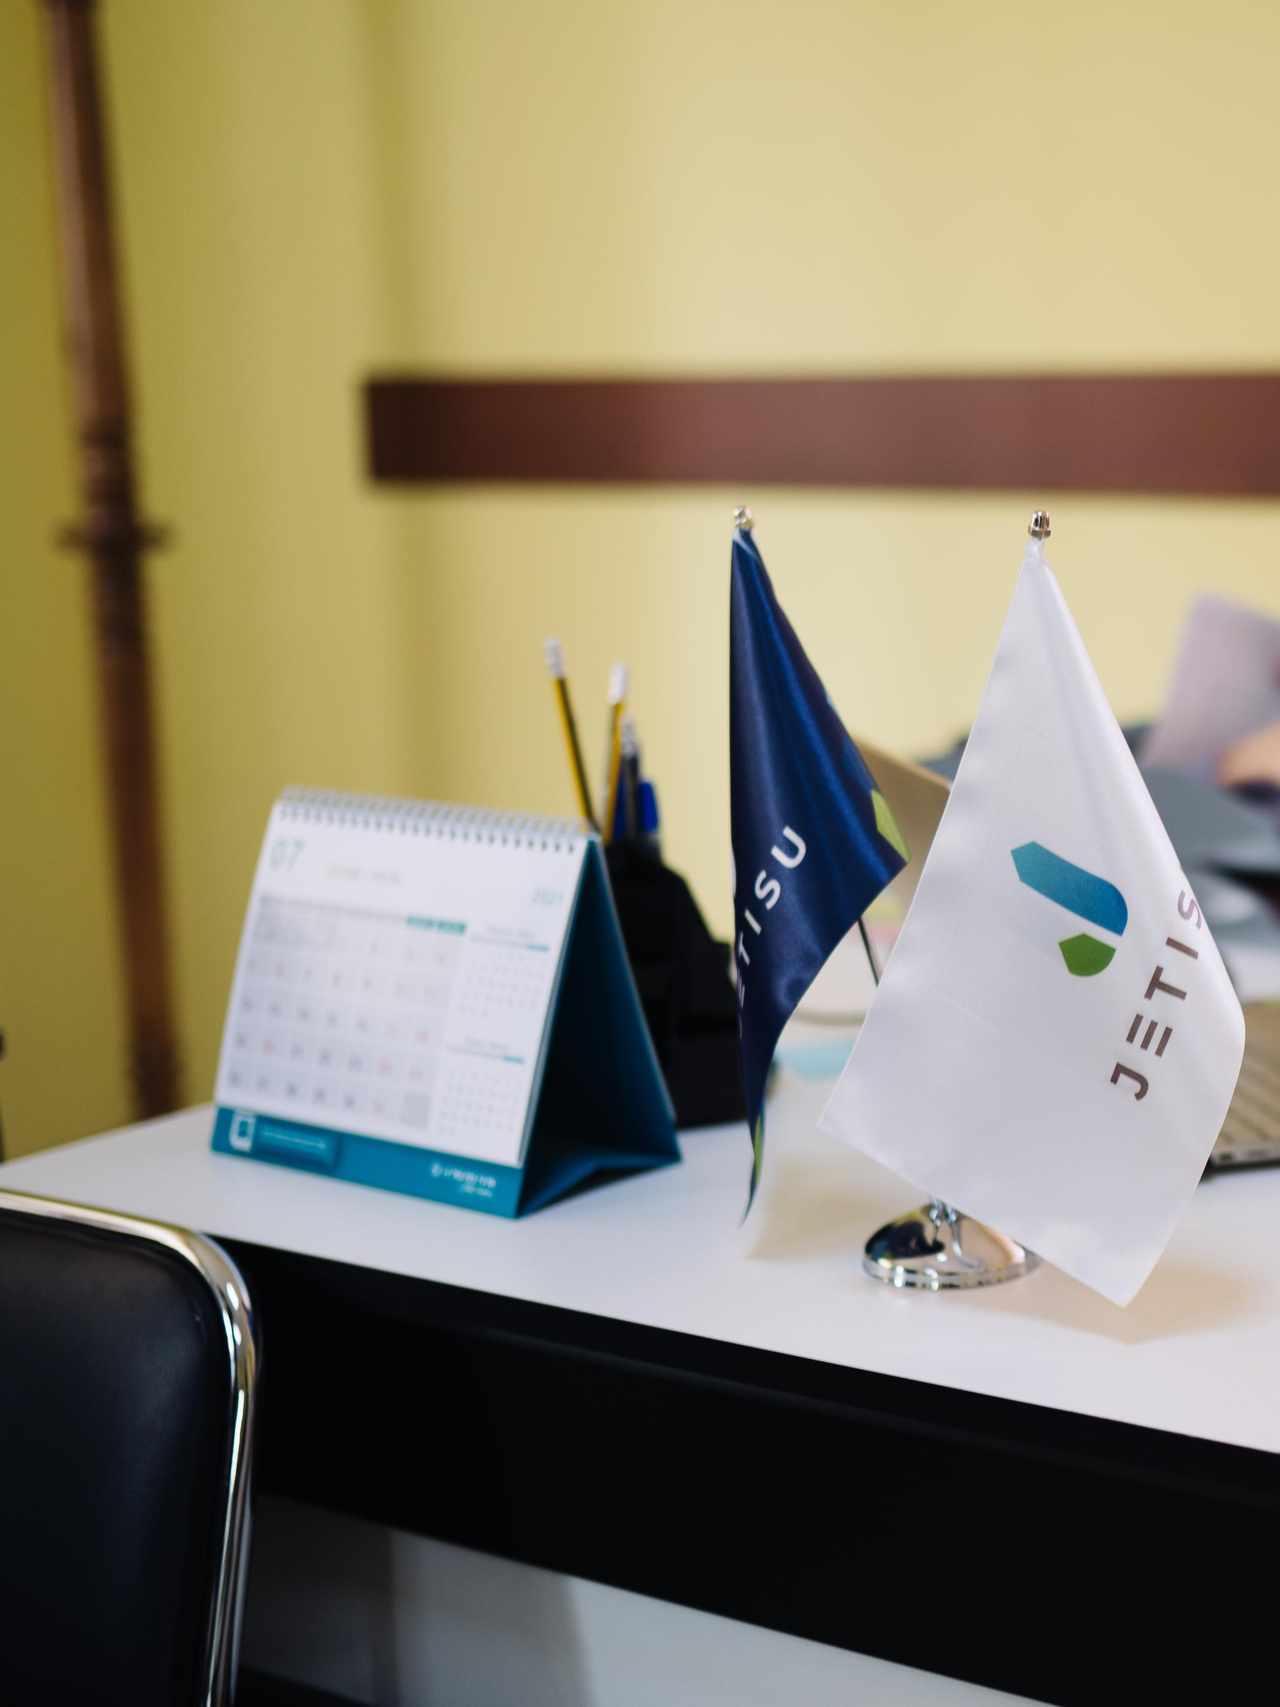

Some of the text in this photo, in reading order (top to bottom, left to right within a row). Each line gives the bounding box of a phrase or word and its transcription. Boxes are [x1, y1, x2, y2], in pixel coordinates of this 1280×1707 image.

[270, 836, 305, 872] 07
[531, 888, 565, 908] 2021
[1110, 866, 1202, 1101] JETIS
